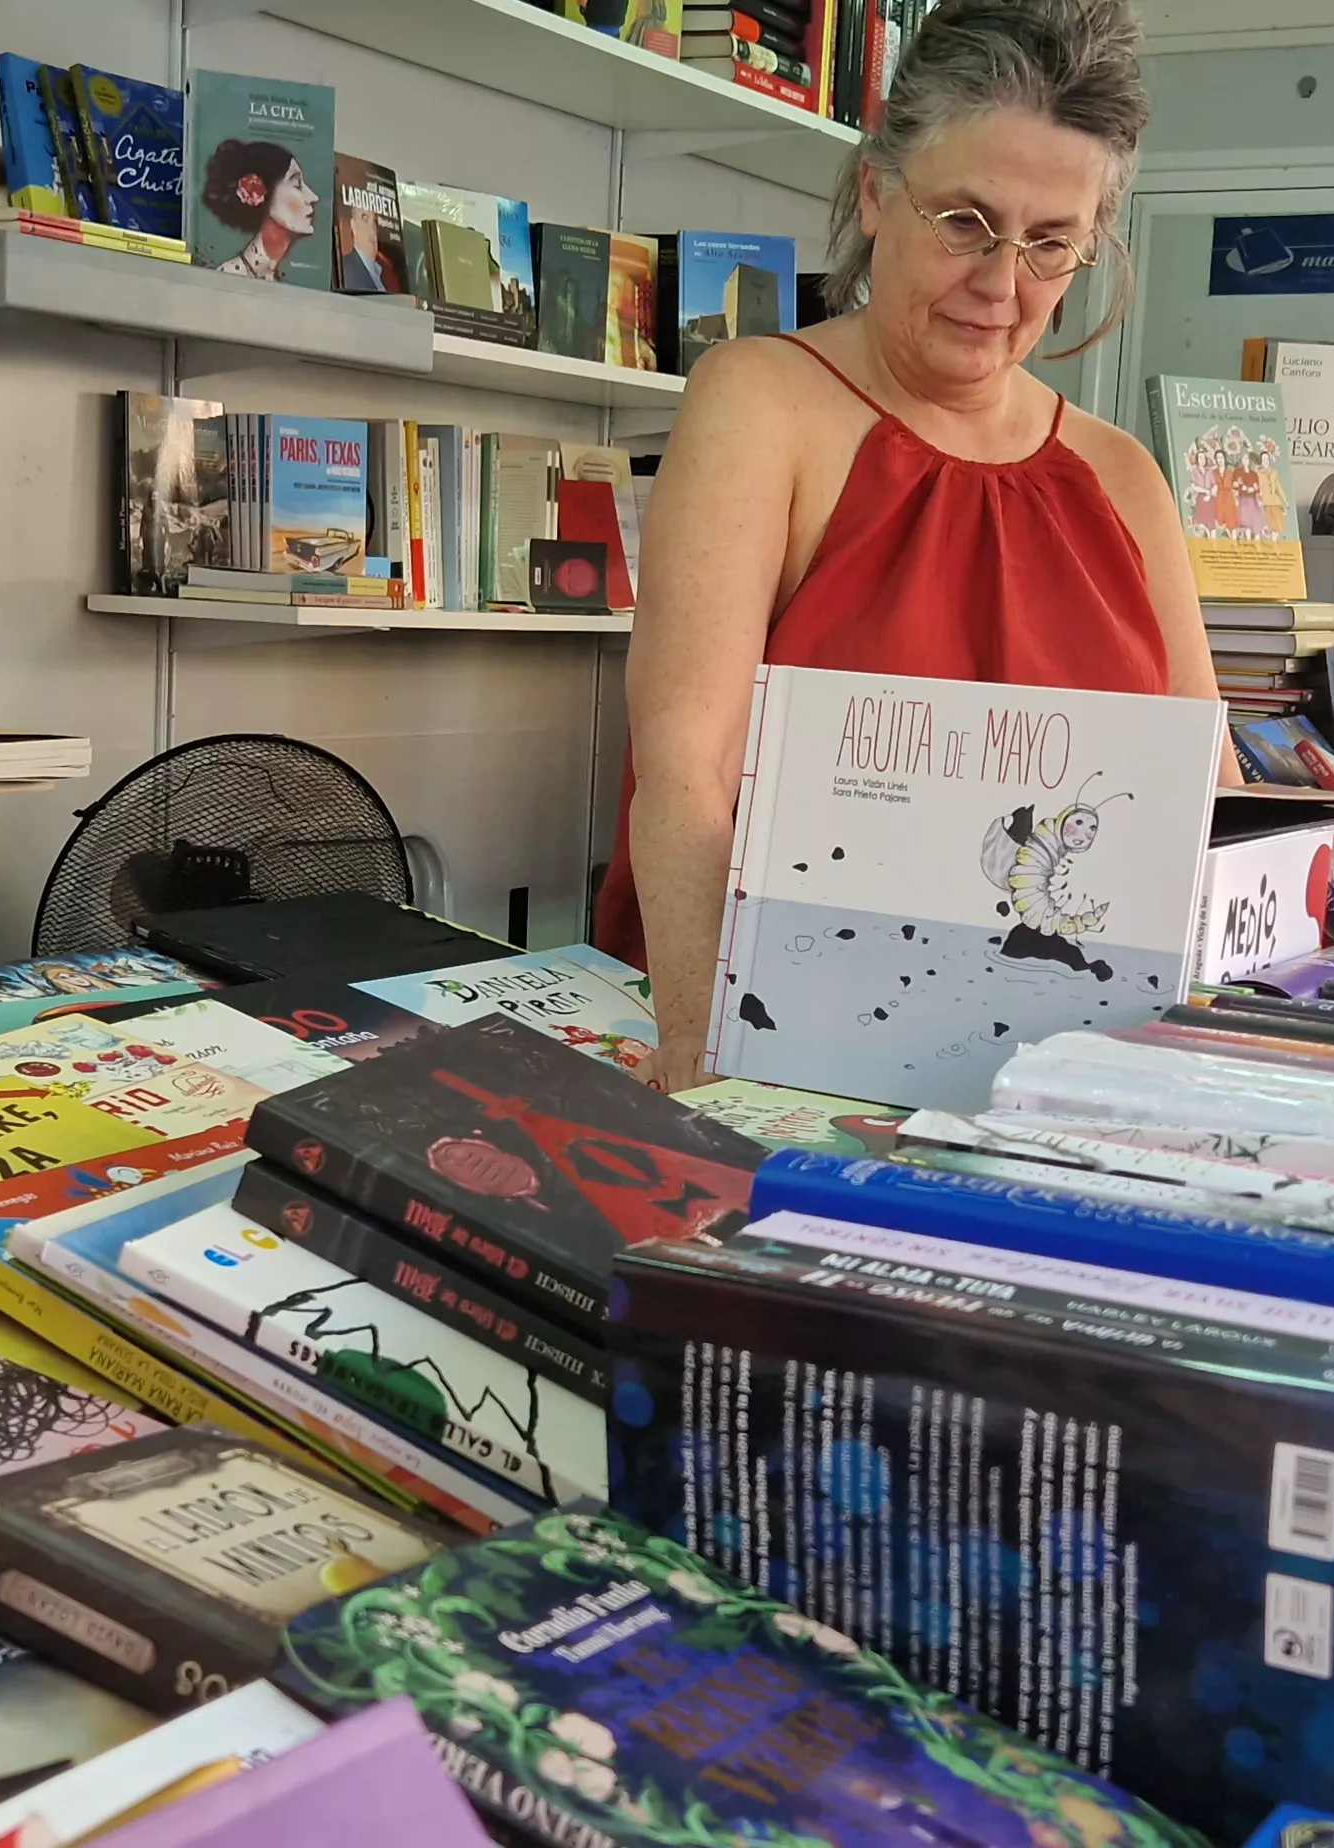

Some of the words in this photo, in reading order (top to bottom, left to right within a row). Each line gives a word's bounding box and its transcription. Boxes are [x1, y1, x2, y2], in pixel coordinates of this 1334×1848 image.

[249, 102, 267, 116] LA
[270, 104, 305, 121] CITA
[342, 185, 398, 218] LABORDETA
[1281, 367, 1322, 379] Canfora
[1282, 355, 1323, 367] Luciano
[1174, 383, 1277, 412] Escritoras
[1285, 416, 1330, 436] ULIO
[279, 436, 321, 467] PARIS,
[324, 440, 362, 470] TEXAS
[835, 689, 933, 777] AGÜITA
[943, 730, 971, 780] DE
[980, 707, 1071, 790] MAYO
[832, 787, 852, 798] Sara
[854, 788, 879, 801] Prieto
[879, 791, 911, 804] Pajares
[833, 775, 858, 788] Laura
[862, 777, 885, 790] Vizán
[886, 780, 909, 792] Linés
[1195, 921, 1207, 942] Vicky
[424, 966, 574, 1004] DANIELA
[497, 992, 594, 1020] PIRATA
[167, 1144, 216, 1163] Mariana
[216, 1136, 241, 1154] Ruiz
[404, 1199, 453, 1243] Bill
[534, 1270, 595, 1313] HIRSCH
[907, 1241, 951, 1259] SIN
[819, 1253, 847, 1273] MI
[848, 1260, 933, 1286] ALMA
[954, 1276, 1018, 1301] TUYA
[392, 1259, 441, 1303] Bill
[523, 1332, 585, 1376] HIRSCH
[88, 1346, 146, 1395] MARIANA
[147, 1383, 182, 1417] RANA
[738, 1350, 752, 1391] joven
[1020, 1421, 1034, 1495] trepidante
[144, 1481, 282, 1552] LADRÓN
[284, 1487, 320, 1503] DE
